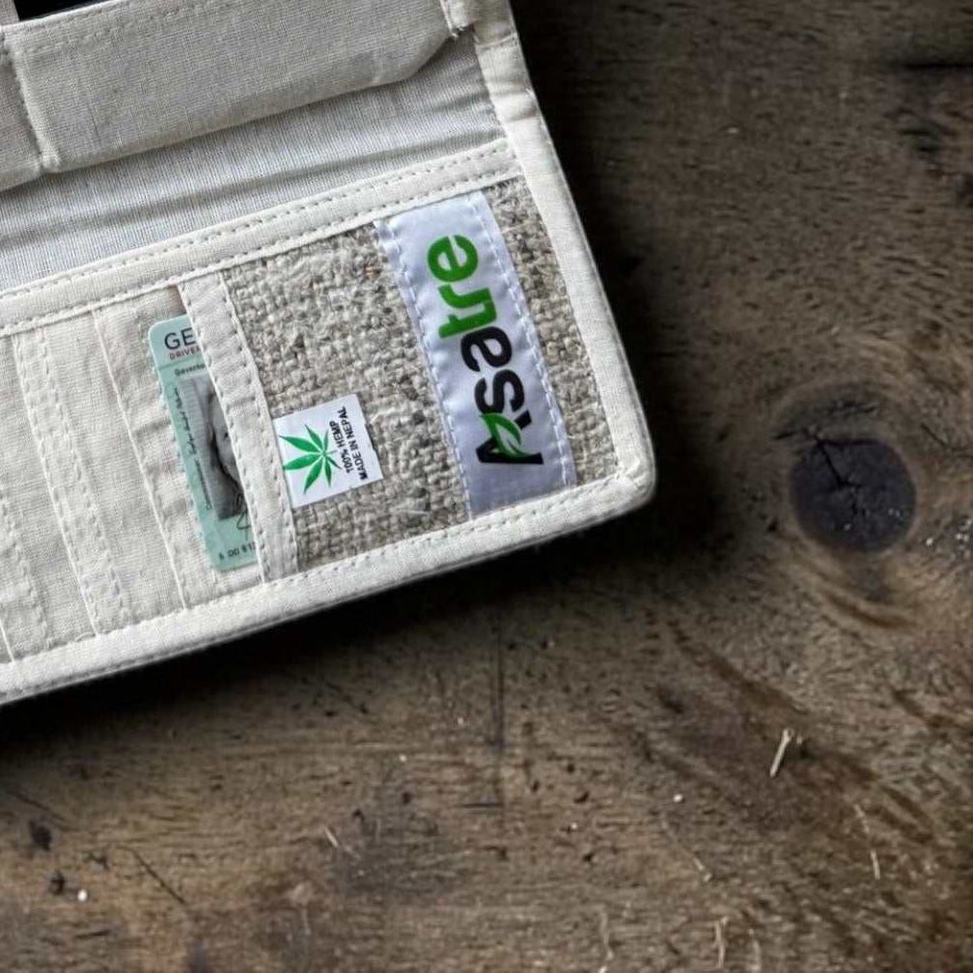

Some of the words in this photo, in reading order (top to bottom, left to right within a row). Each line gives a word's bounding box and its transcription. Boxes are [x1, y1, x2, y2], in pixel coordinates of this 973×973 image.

[329, 420, 346, 448] HEMP
[337, 405, 355, 439] NEPAL
[348, 439, 359, 452] IN
[340, 448, 355, 474] 100%
[352, 451, 368, 480] MADE
